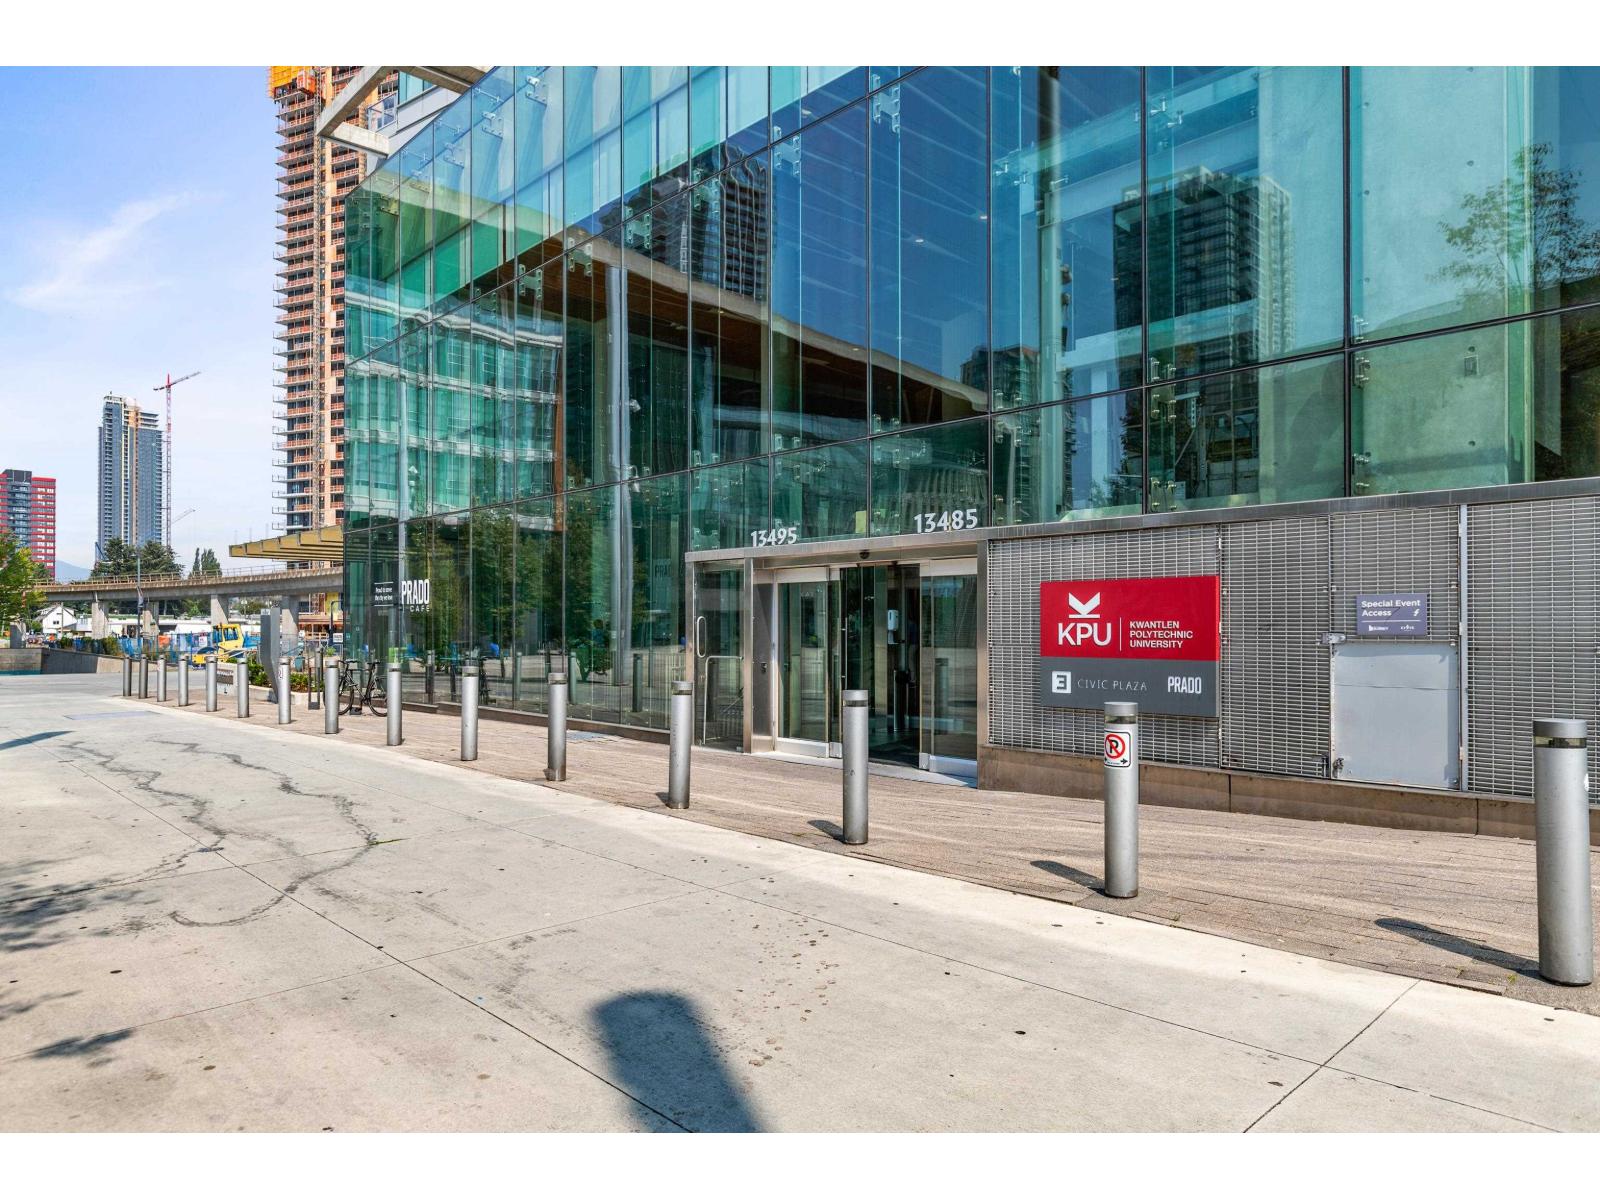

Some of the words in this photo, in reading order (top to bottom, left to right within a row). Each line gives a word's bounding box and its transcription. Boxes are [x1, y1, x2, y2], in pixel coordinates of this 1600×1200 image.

[913, 508, 978, 533] 13485
[750, 527, 798, 548] 13495
[401, 579, 430, 604] PRADO
[1361, 600, 1393, 608] Special
[1129, 620, 1180, 629] KWANTLEN
[1058, 622, 1112, 646] KPU
[1129, 630, 1194, 639] POLYTECHNIC
[1129, 639, 1183, 648] UNIVERSITY
[1077, 679, 1108, 690] CIVIC
[1113, 680, 1147, 691] PLAZA
[1167, 676, 1202, 694] PRADO
